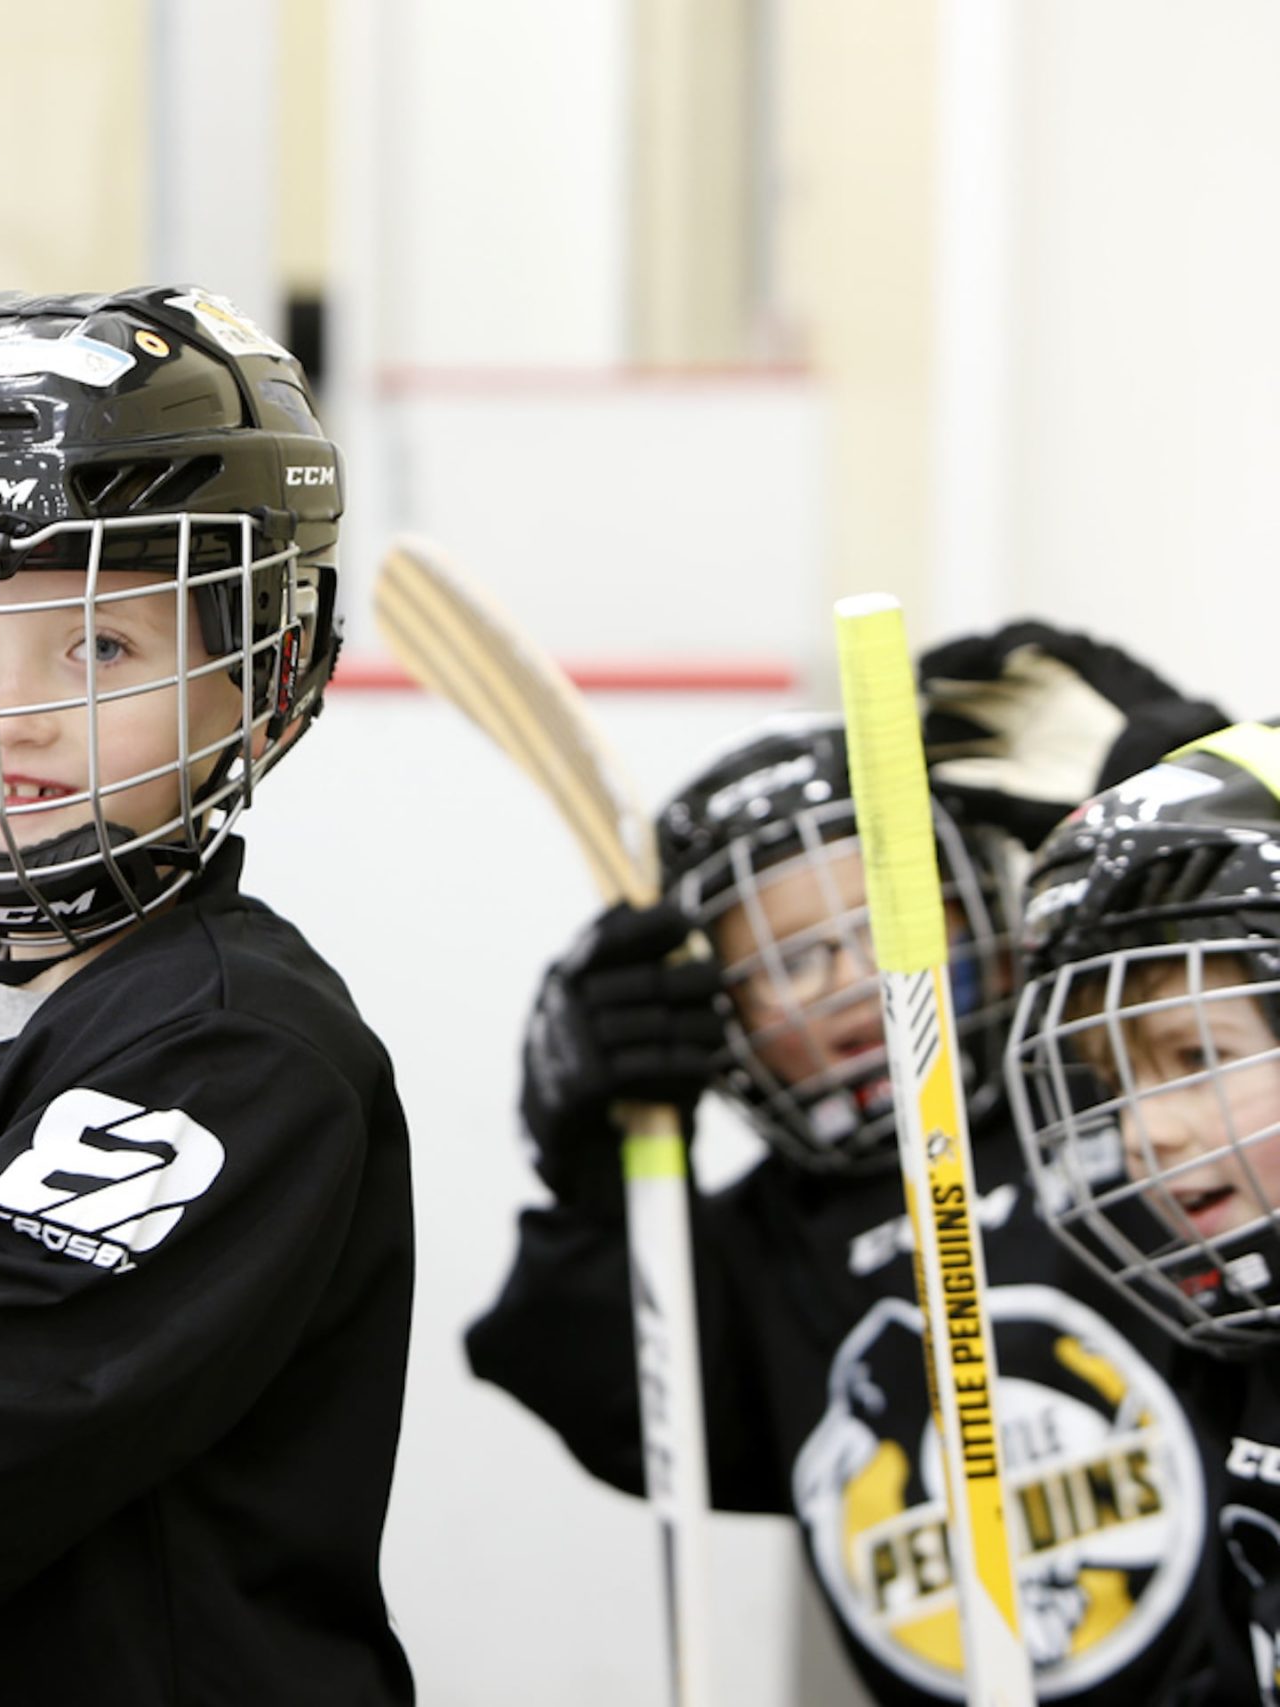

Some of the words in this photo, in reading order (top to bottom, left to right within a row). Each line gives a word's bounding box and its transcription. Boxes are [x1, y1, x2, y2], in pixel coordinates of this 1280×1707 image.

[287, 466, 335, 486] CCM
[932, 1182, 985, 1365] PENGUINS
[954, 1374, 997, 1480] LITTLE
[872, 1446, 1162, 1614] PEUINS
